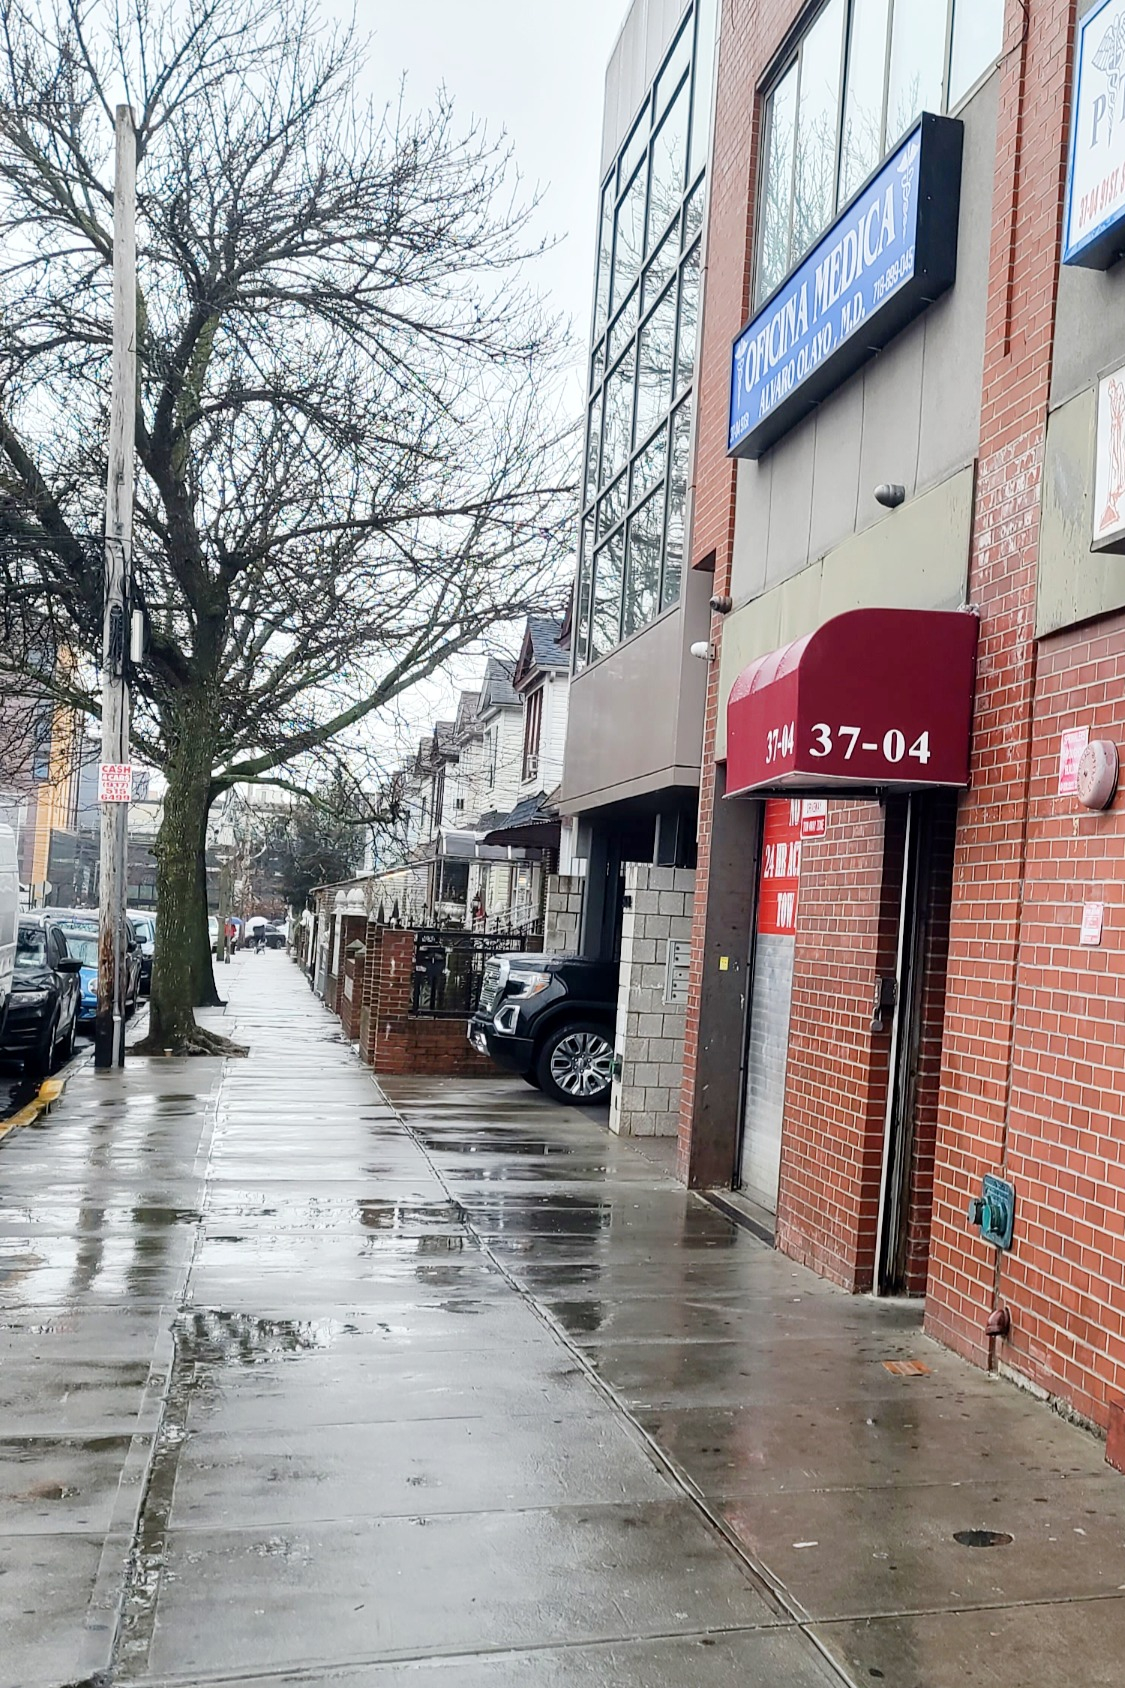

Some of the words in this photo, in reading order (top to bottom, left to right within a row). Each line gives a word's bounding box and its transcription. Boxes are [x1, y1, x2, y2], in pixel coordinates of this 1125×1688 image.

[1089, 93, 1107, 149] P
[745, 281, 809, 393] OFICINA
[813, 183, 896, 324] MEDICA
[759, 358, 795, 419] ALVARO
[840, 291, 866, 340] M.D.
[765, 721, 795, 765] 37-04
[809, 723, 931, 764] 37-04
[102, 765, 131, 774] CASH
[764, 844, 775, 878] 24
[776, 892, 795, 928] TOW
